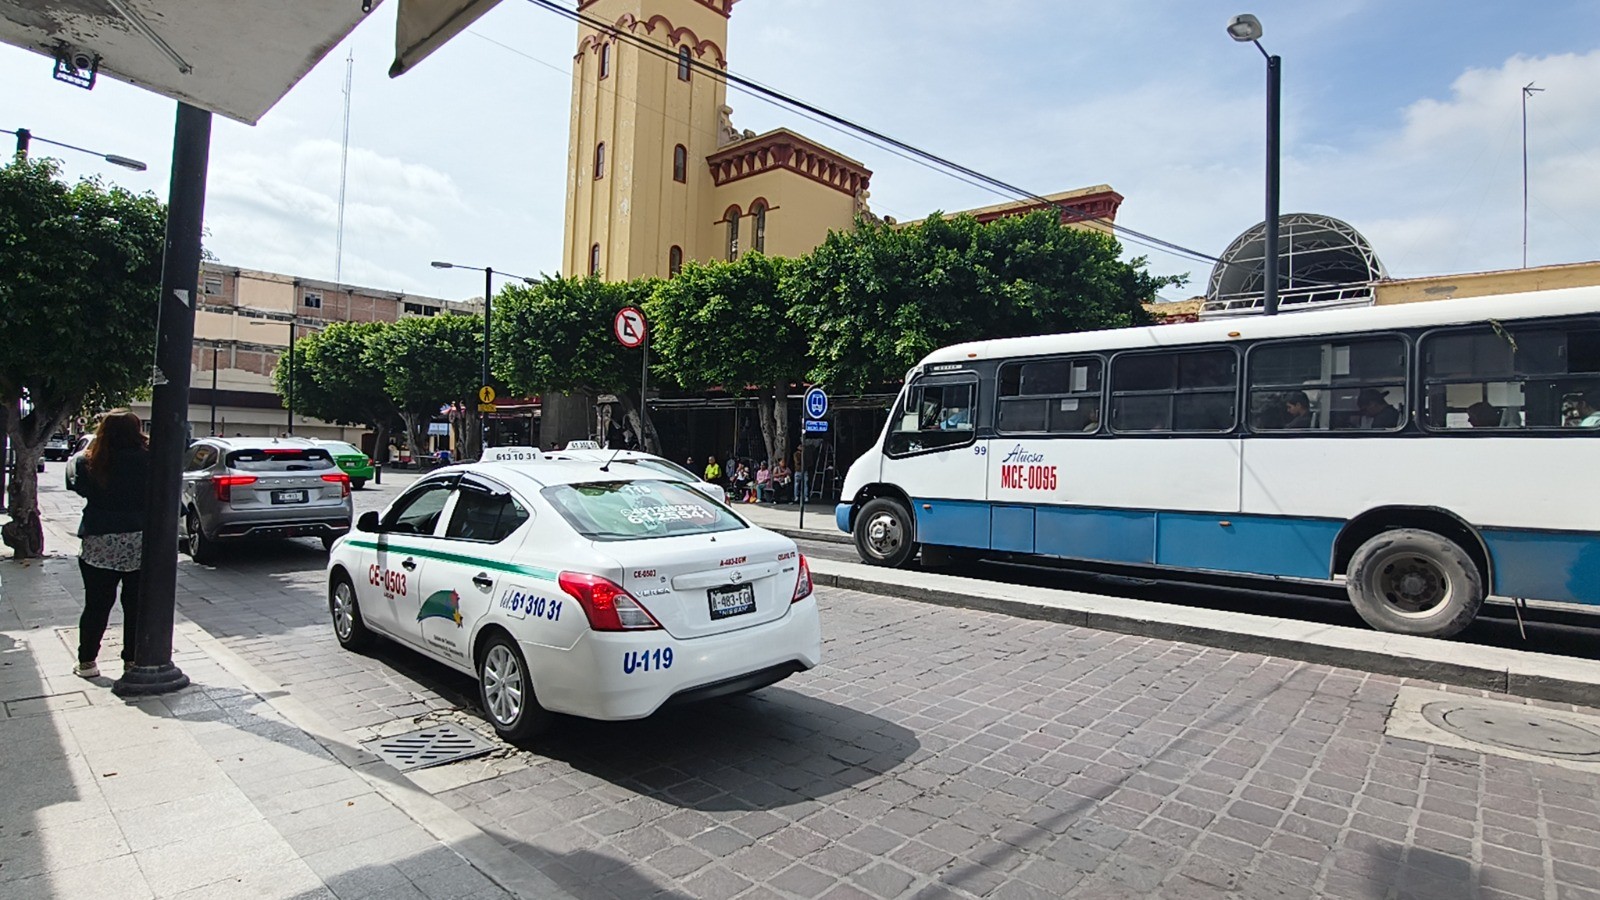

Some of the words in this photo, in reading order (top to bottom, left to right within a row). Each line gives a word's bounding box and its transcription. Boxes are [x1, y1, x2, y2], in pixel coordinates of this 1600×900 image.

[974, 446, 986, 456] 99
[1002, 443, 1044, 463] Atucsa
[1001, 465, 1057, 490] MCE-0095
[369, 563, 407, 597] CE-0503
[633, 569, 656, 578] CE-0503
[635, 588, 671, 597] VERSA
[512, 591, 526, 611] 61
[526, 594, 546, 617] 310
[547, 600, 562, 621] 31
[623, 647, 674, 675] U-119
